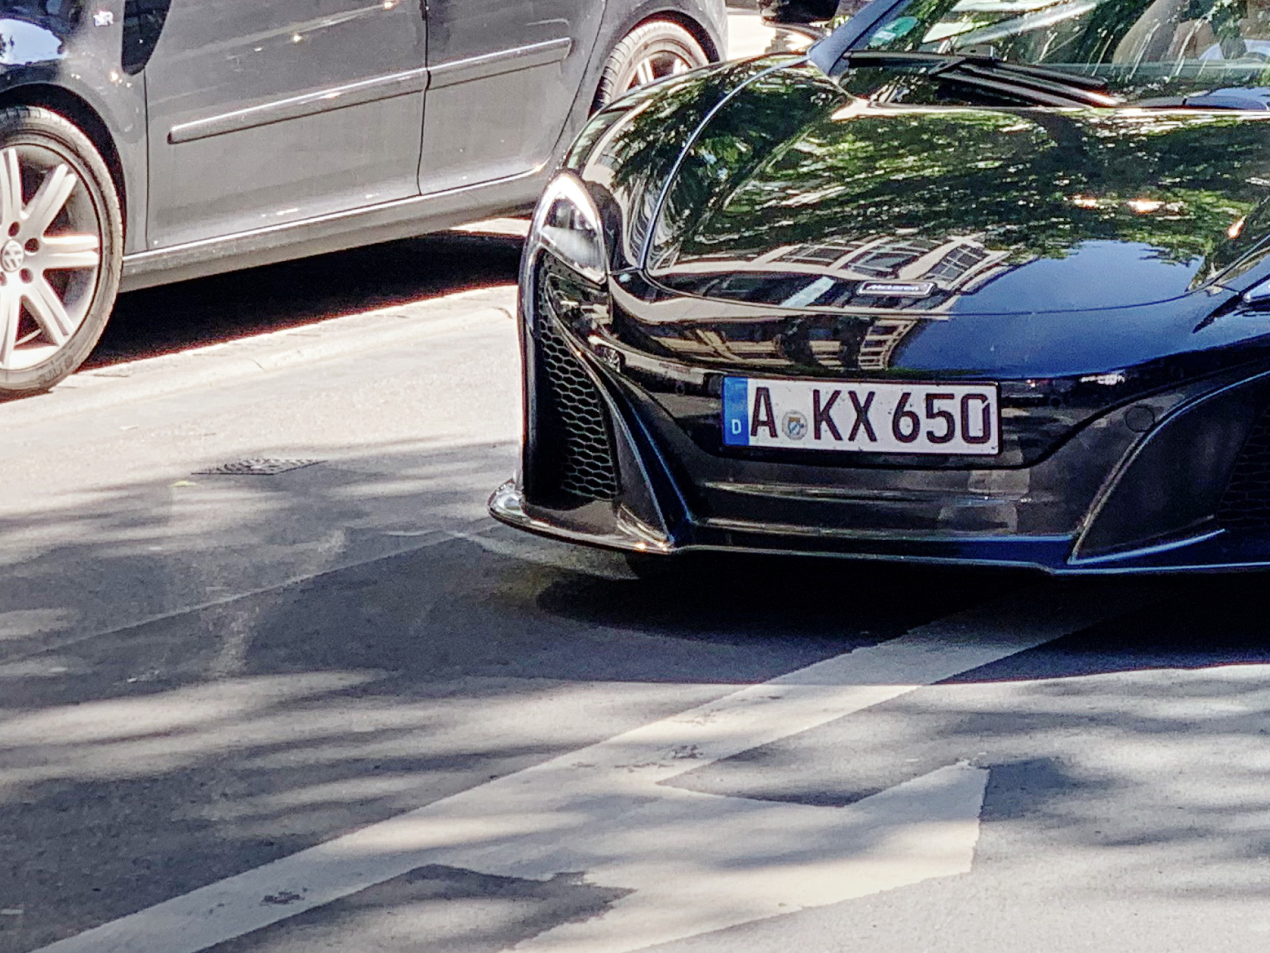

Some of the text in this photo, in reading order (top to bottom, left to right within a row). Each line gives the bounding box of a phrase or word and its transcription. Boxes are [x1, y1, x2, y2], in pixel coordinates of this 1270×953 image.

[731, 386, 992, 445] D A KX 650
